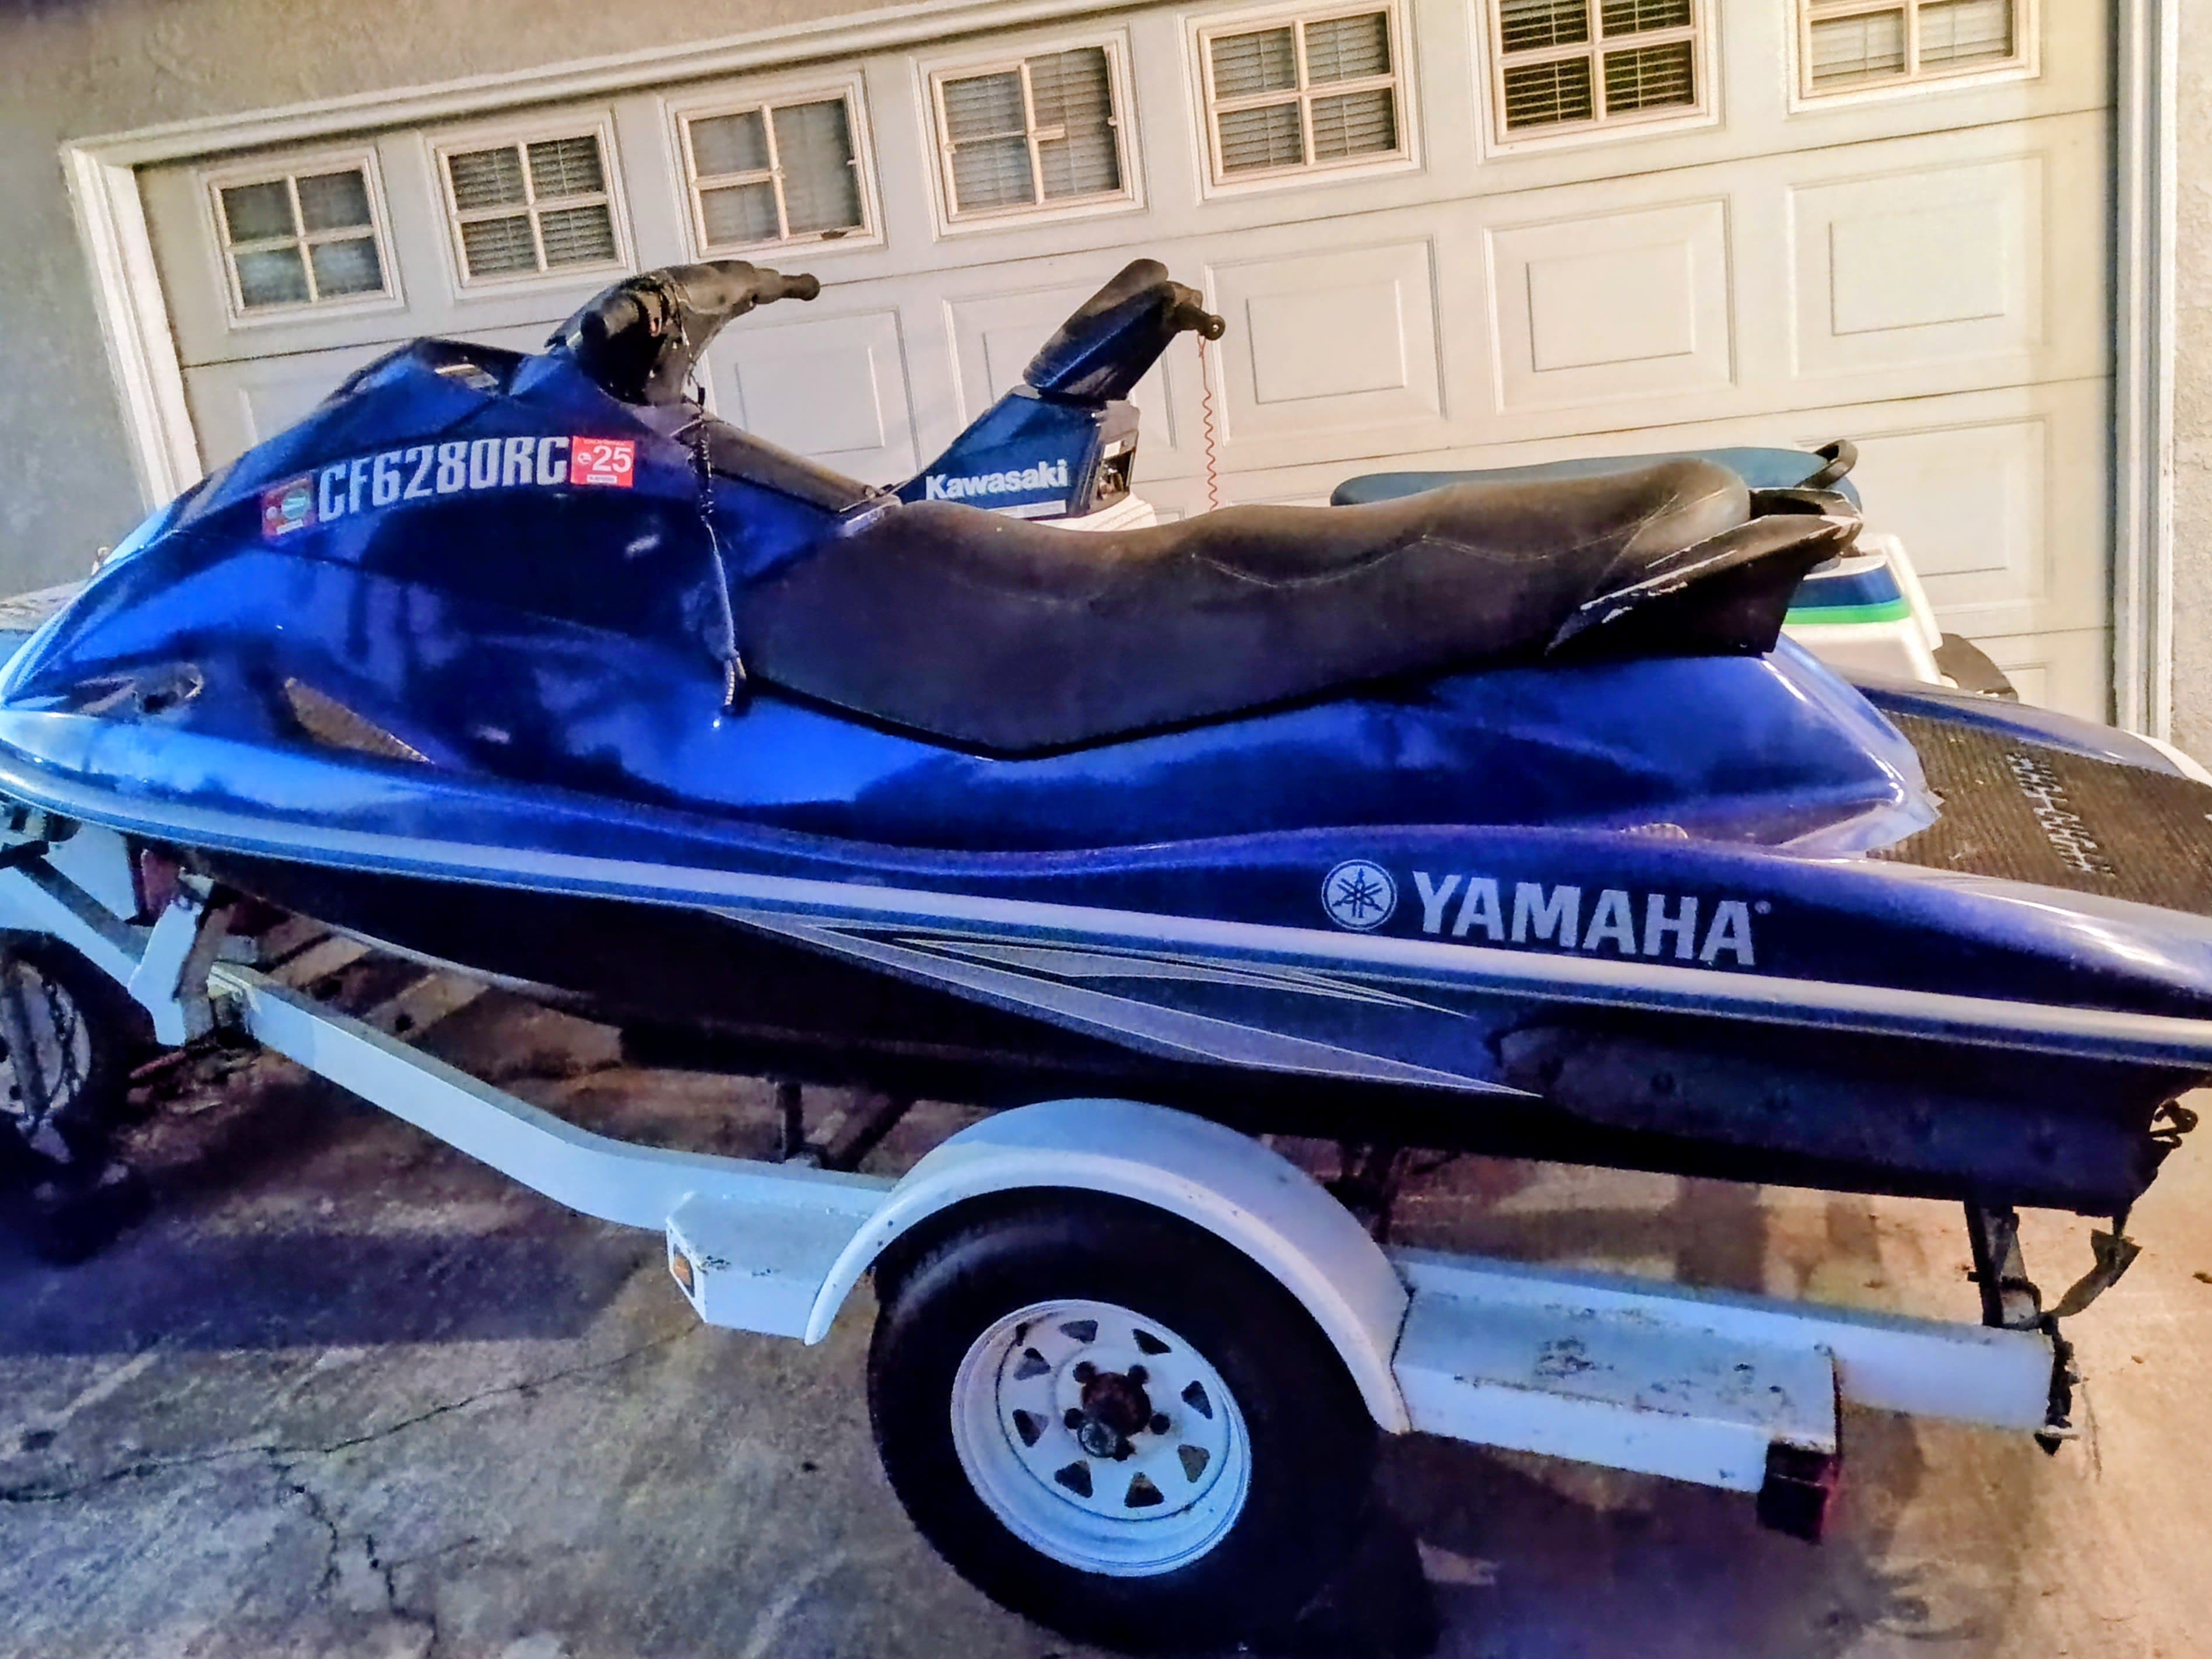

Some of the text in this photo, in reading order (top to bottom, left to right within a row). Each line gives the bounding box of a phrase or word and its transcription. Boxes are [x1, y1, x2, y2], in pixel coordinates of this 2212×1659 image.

[318, 437, 570, 522] CF6280RC
[592, 445, 632, 473] 25
[925, 459, 1069, 500] Kawasaki
[1412, 871, 1755, 966] YAMAHA
